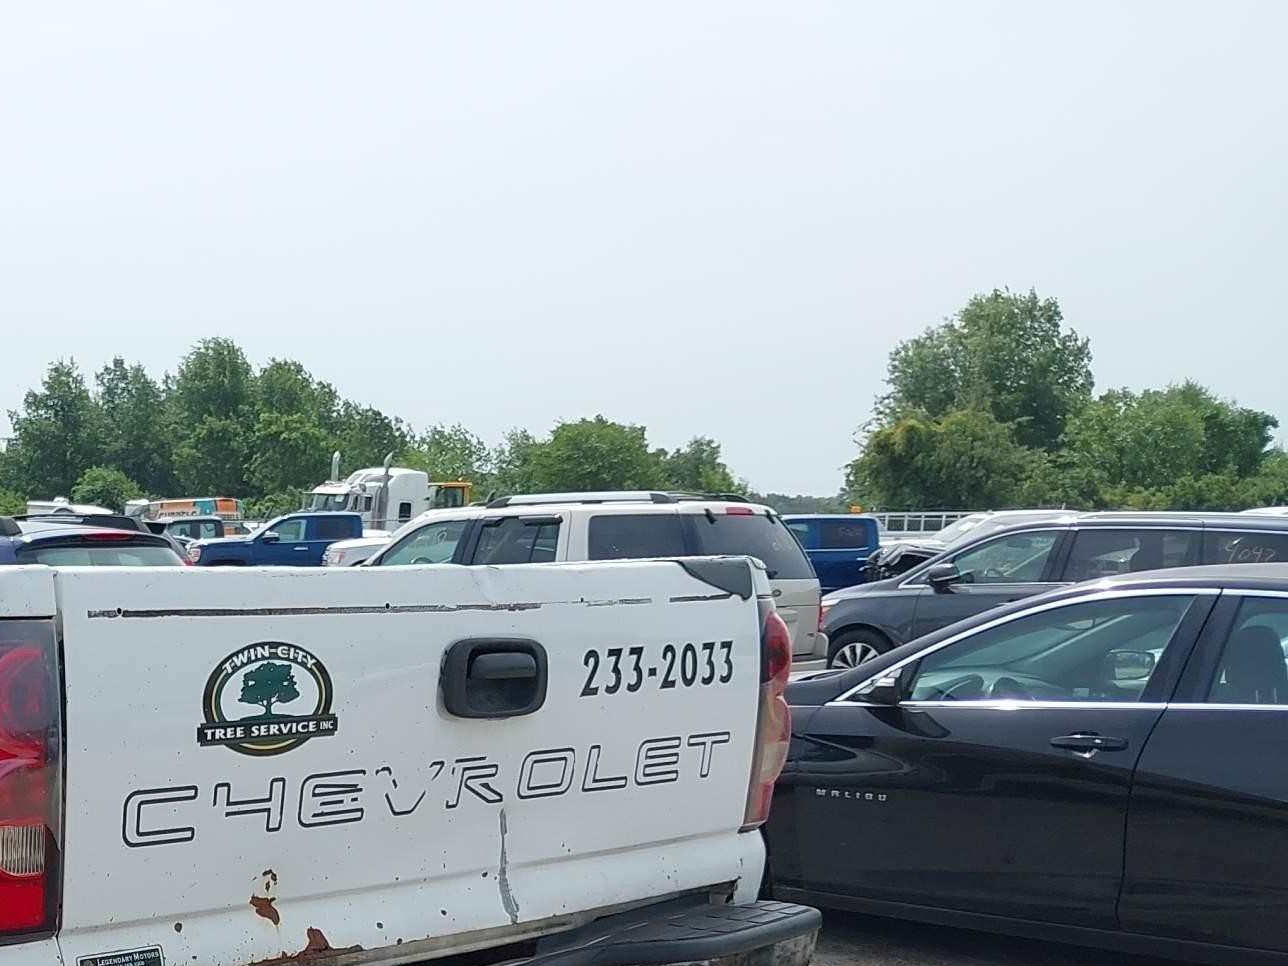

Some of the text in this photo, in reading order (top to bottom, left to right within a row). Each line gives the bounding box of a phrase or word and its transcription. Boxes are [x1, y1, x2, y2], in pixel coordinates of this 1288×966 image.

[222, 644, 318, 674] TWIN-CITY
[578, 640, 734, 697] 233-2033
[204, 720, 334, 741] TREE SERVICE INC
[122, 731, 731, 848] CHEVROLET
[815, 788, 888, 801] MALIBU
